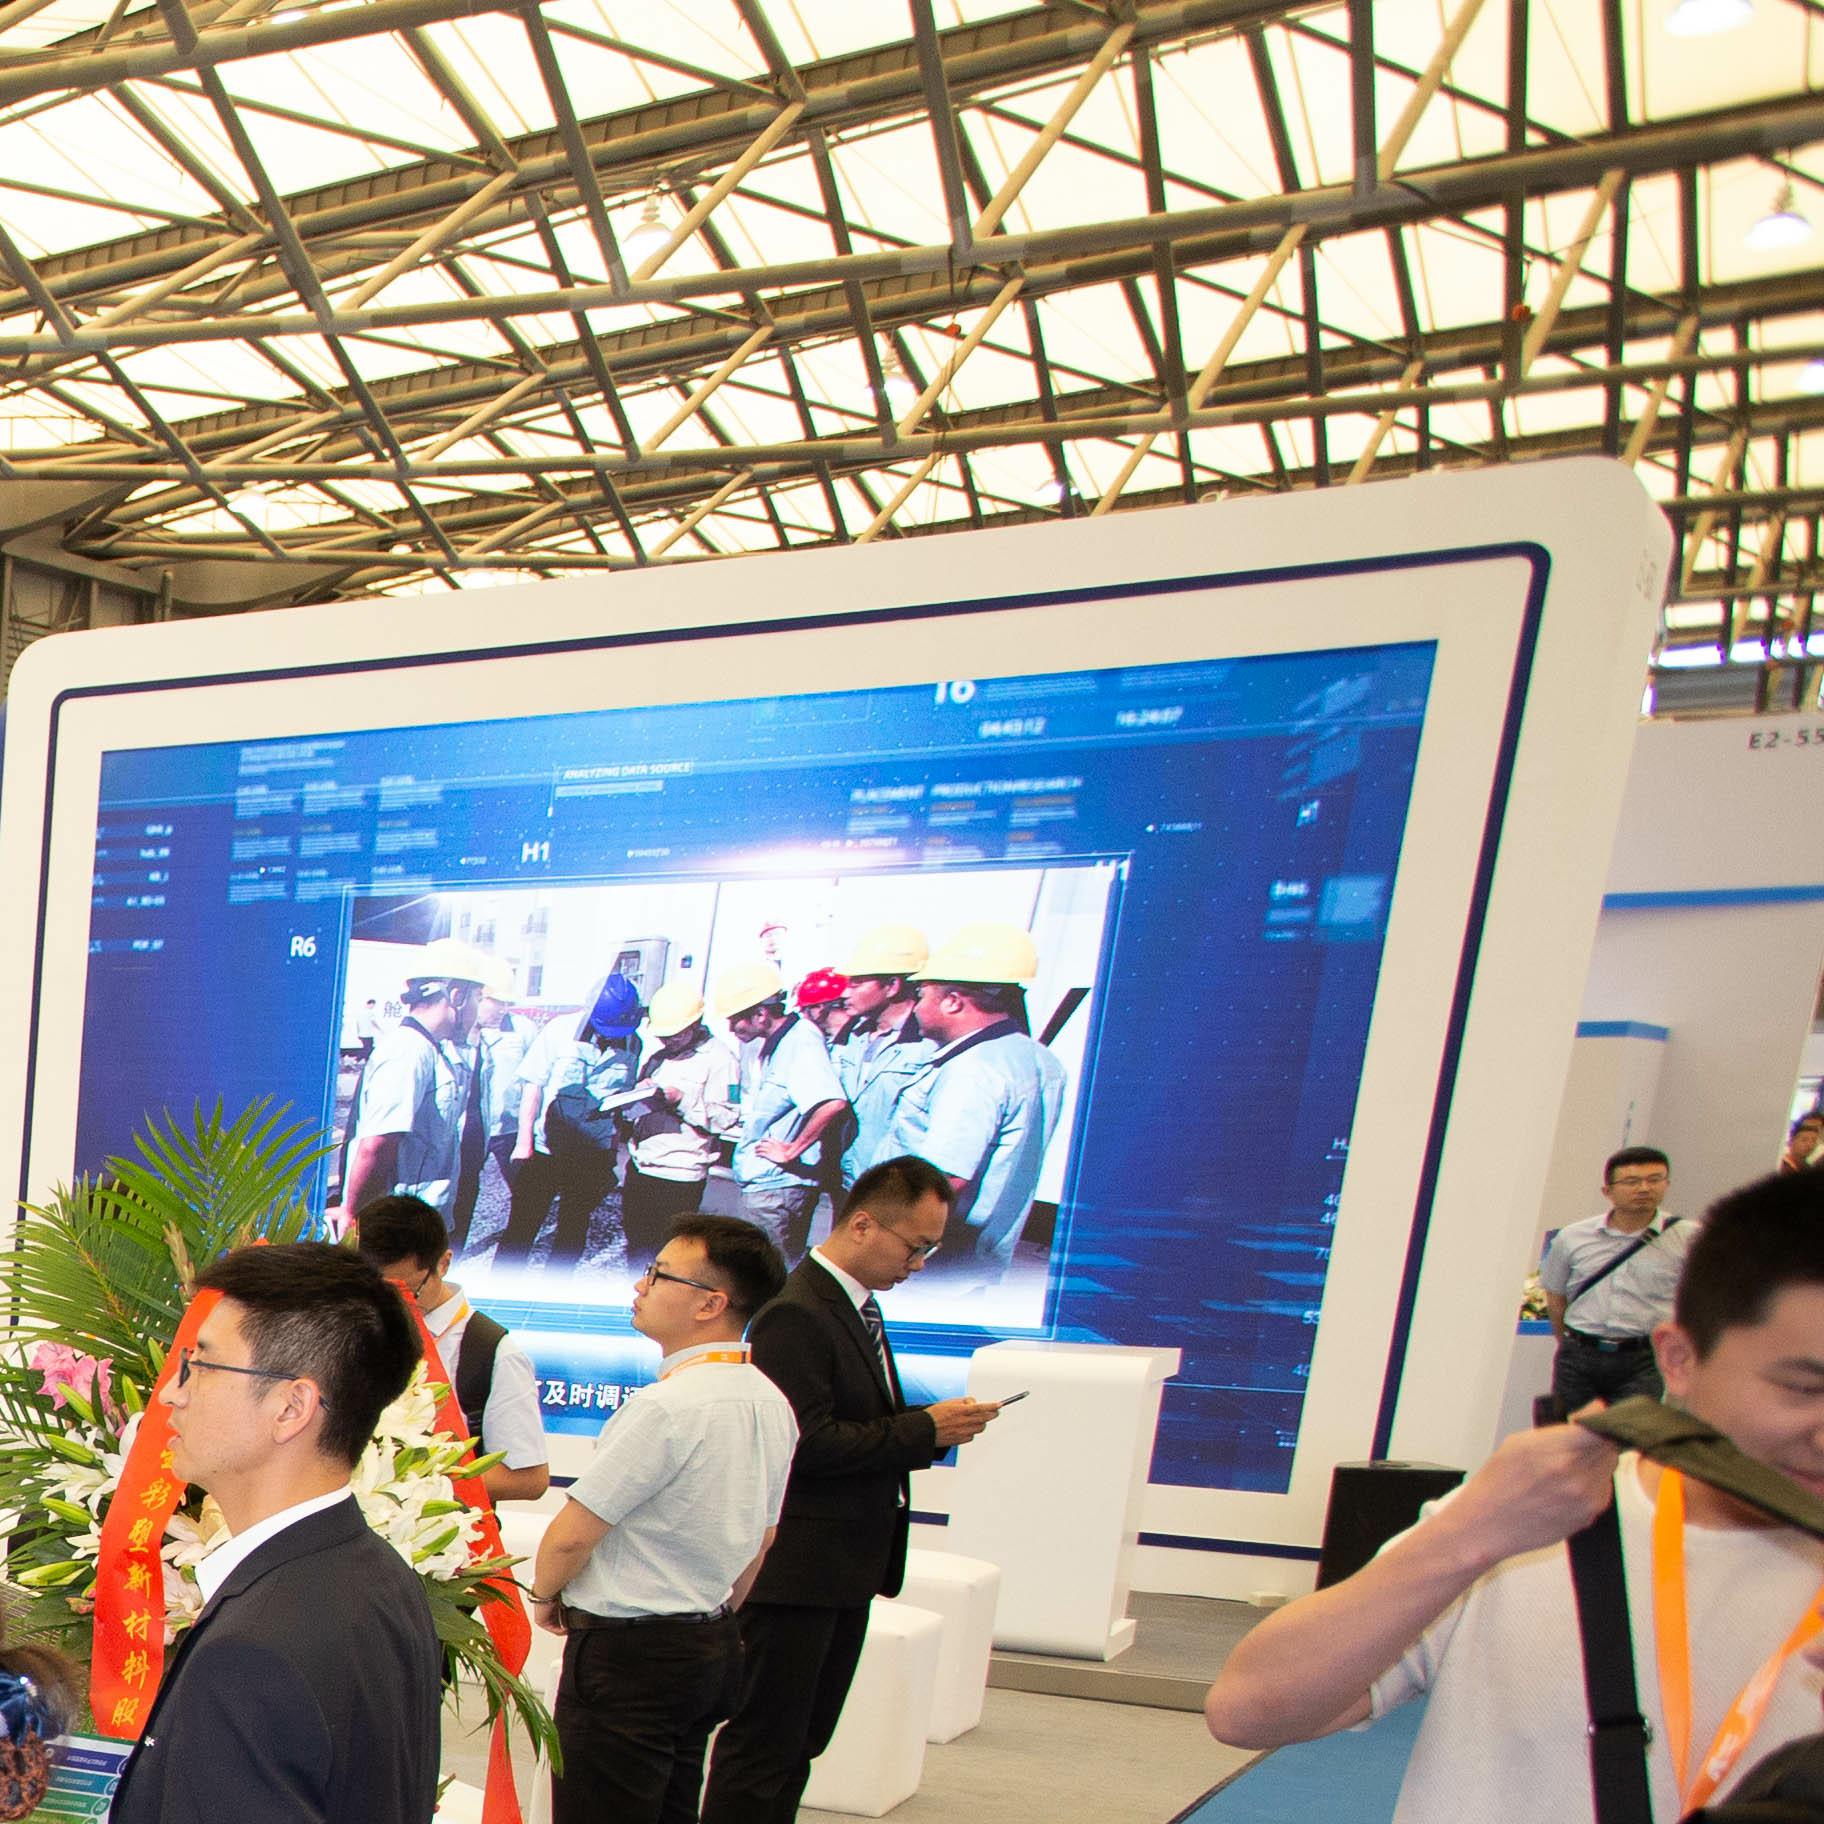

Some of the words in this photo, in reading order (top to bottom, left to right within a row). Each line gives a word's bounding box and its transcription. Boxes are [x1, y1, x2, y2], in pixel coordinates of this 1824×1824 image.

[521, 841, 551, 864] H1
[290, 935, 316, 957] R6
[536, 1380, 646, 1410] 及时调
